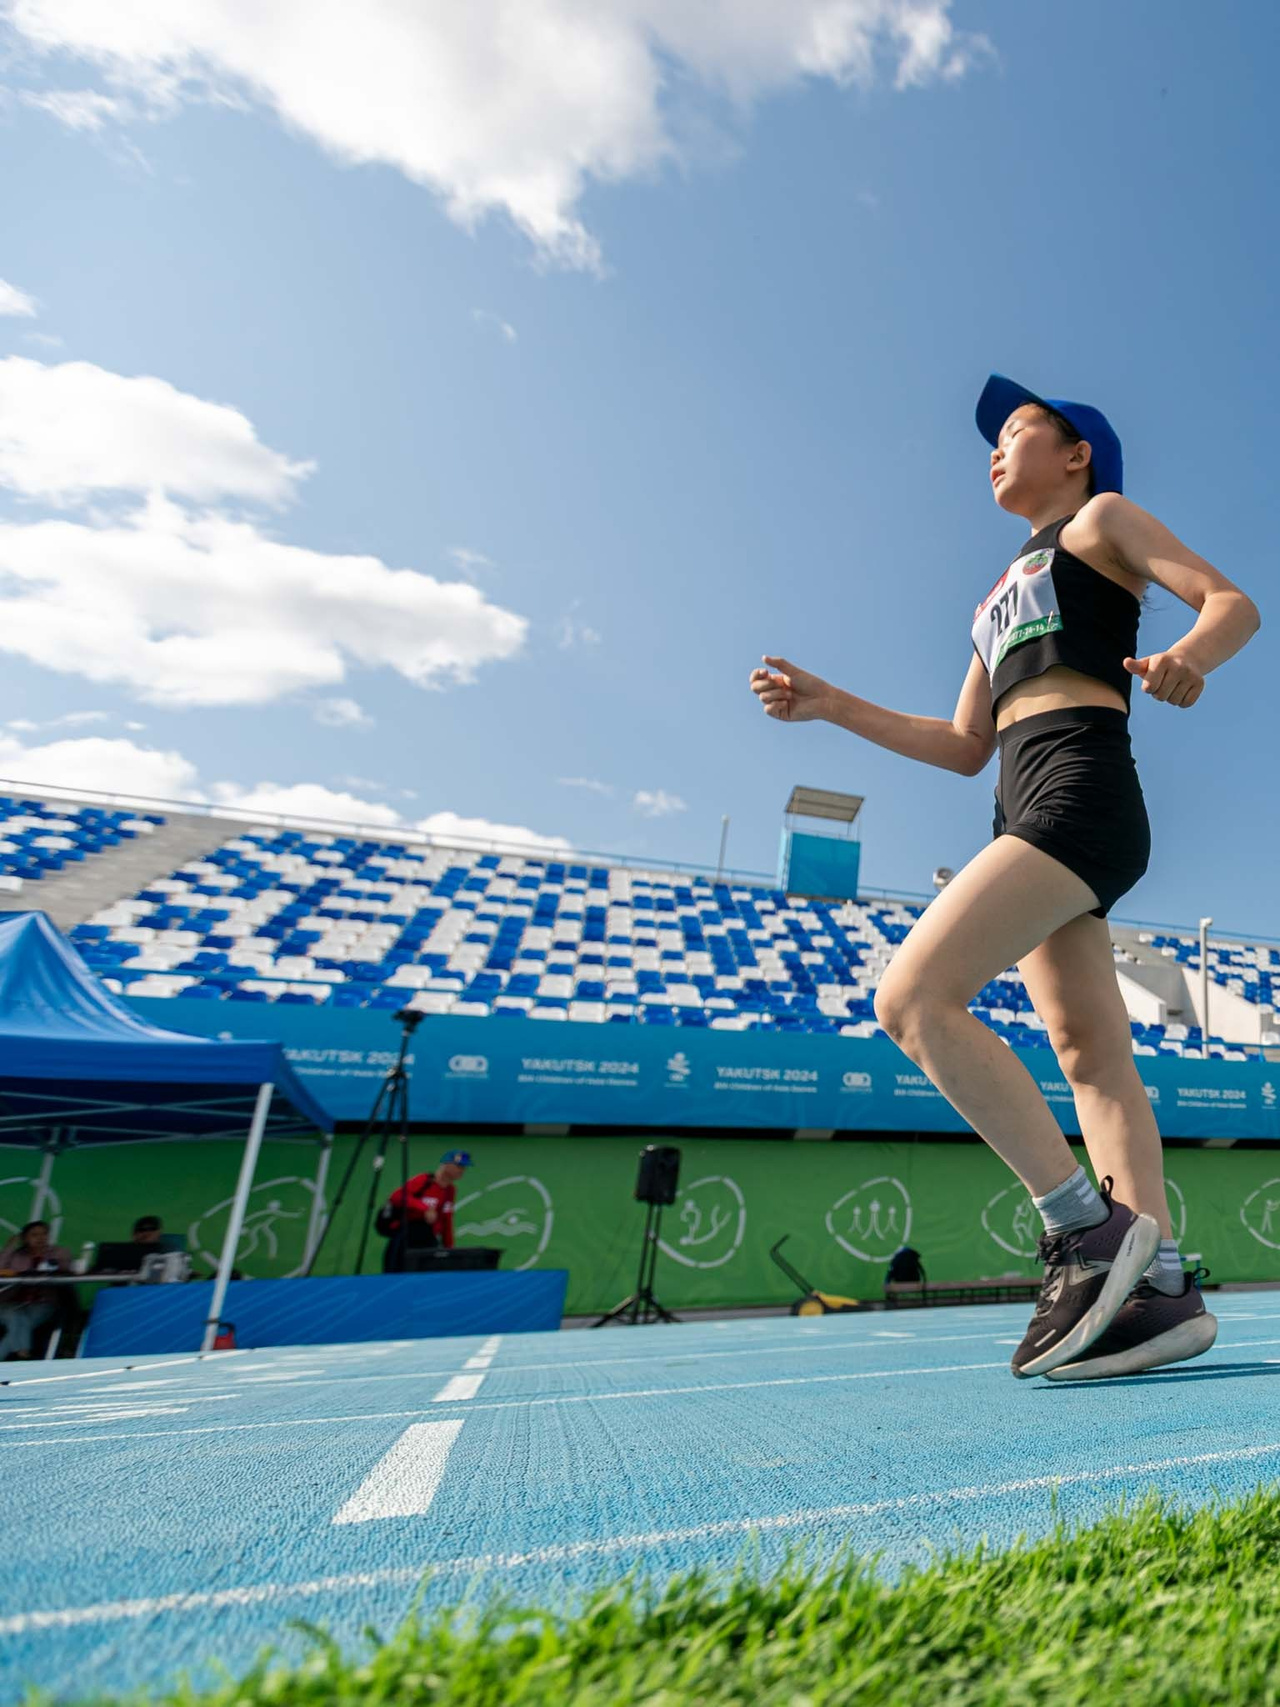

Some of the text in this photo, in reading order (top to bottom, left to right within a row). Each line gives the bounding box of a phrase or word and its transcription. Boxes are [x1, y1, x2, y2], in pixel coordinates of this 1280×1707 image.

[521, 1058, 639, 1074] YAKUTSK 2024
[716, 1067, 818, 1081] YAKUTSK 2024
[1177, 1087, 1247, 1100] YAKUTSK 2024
